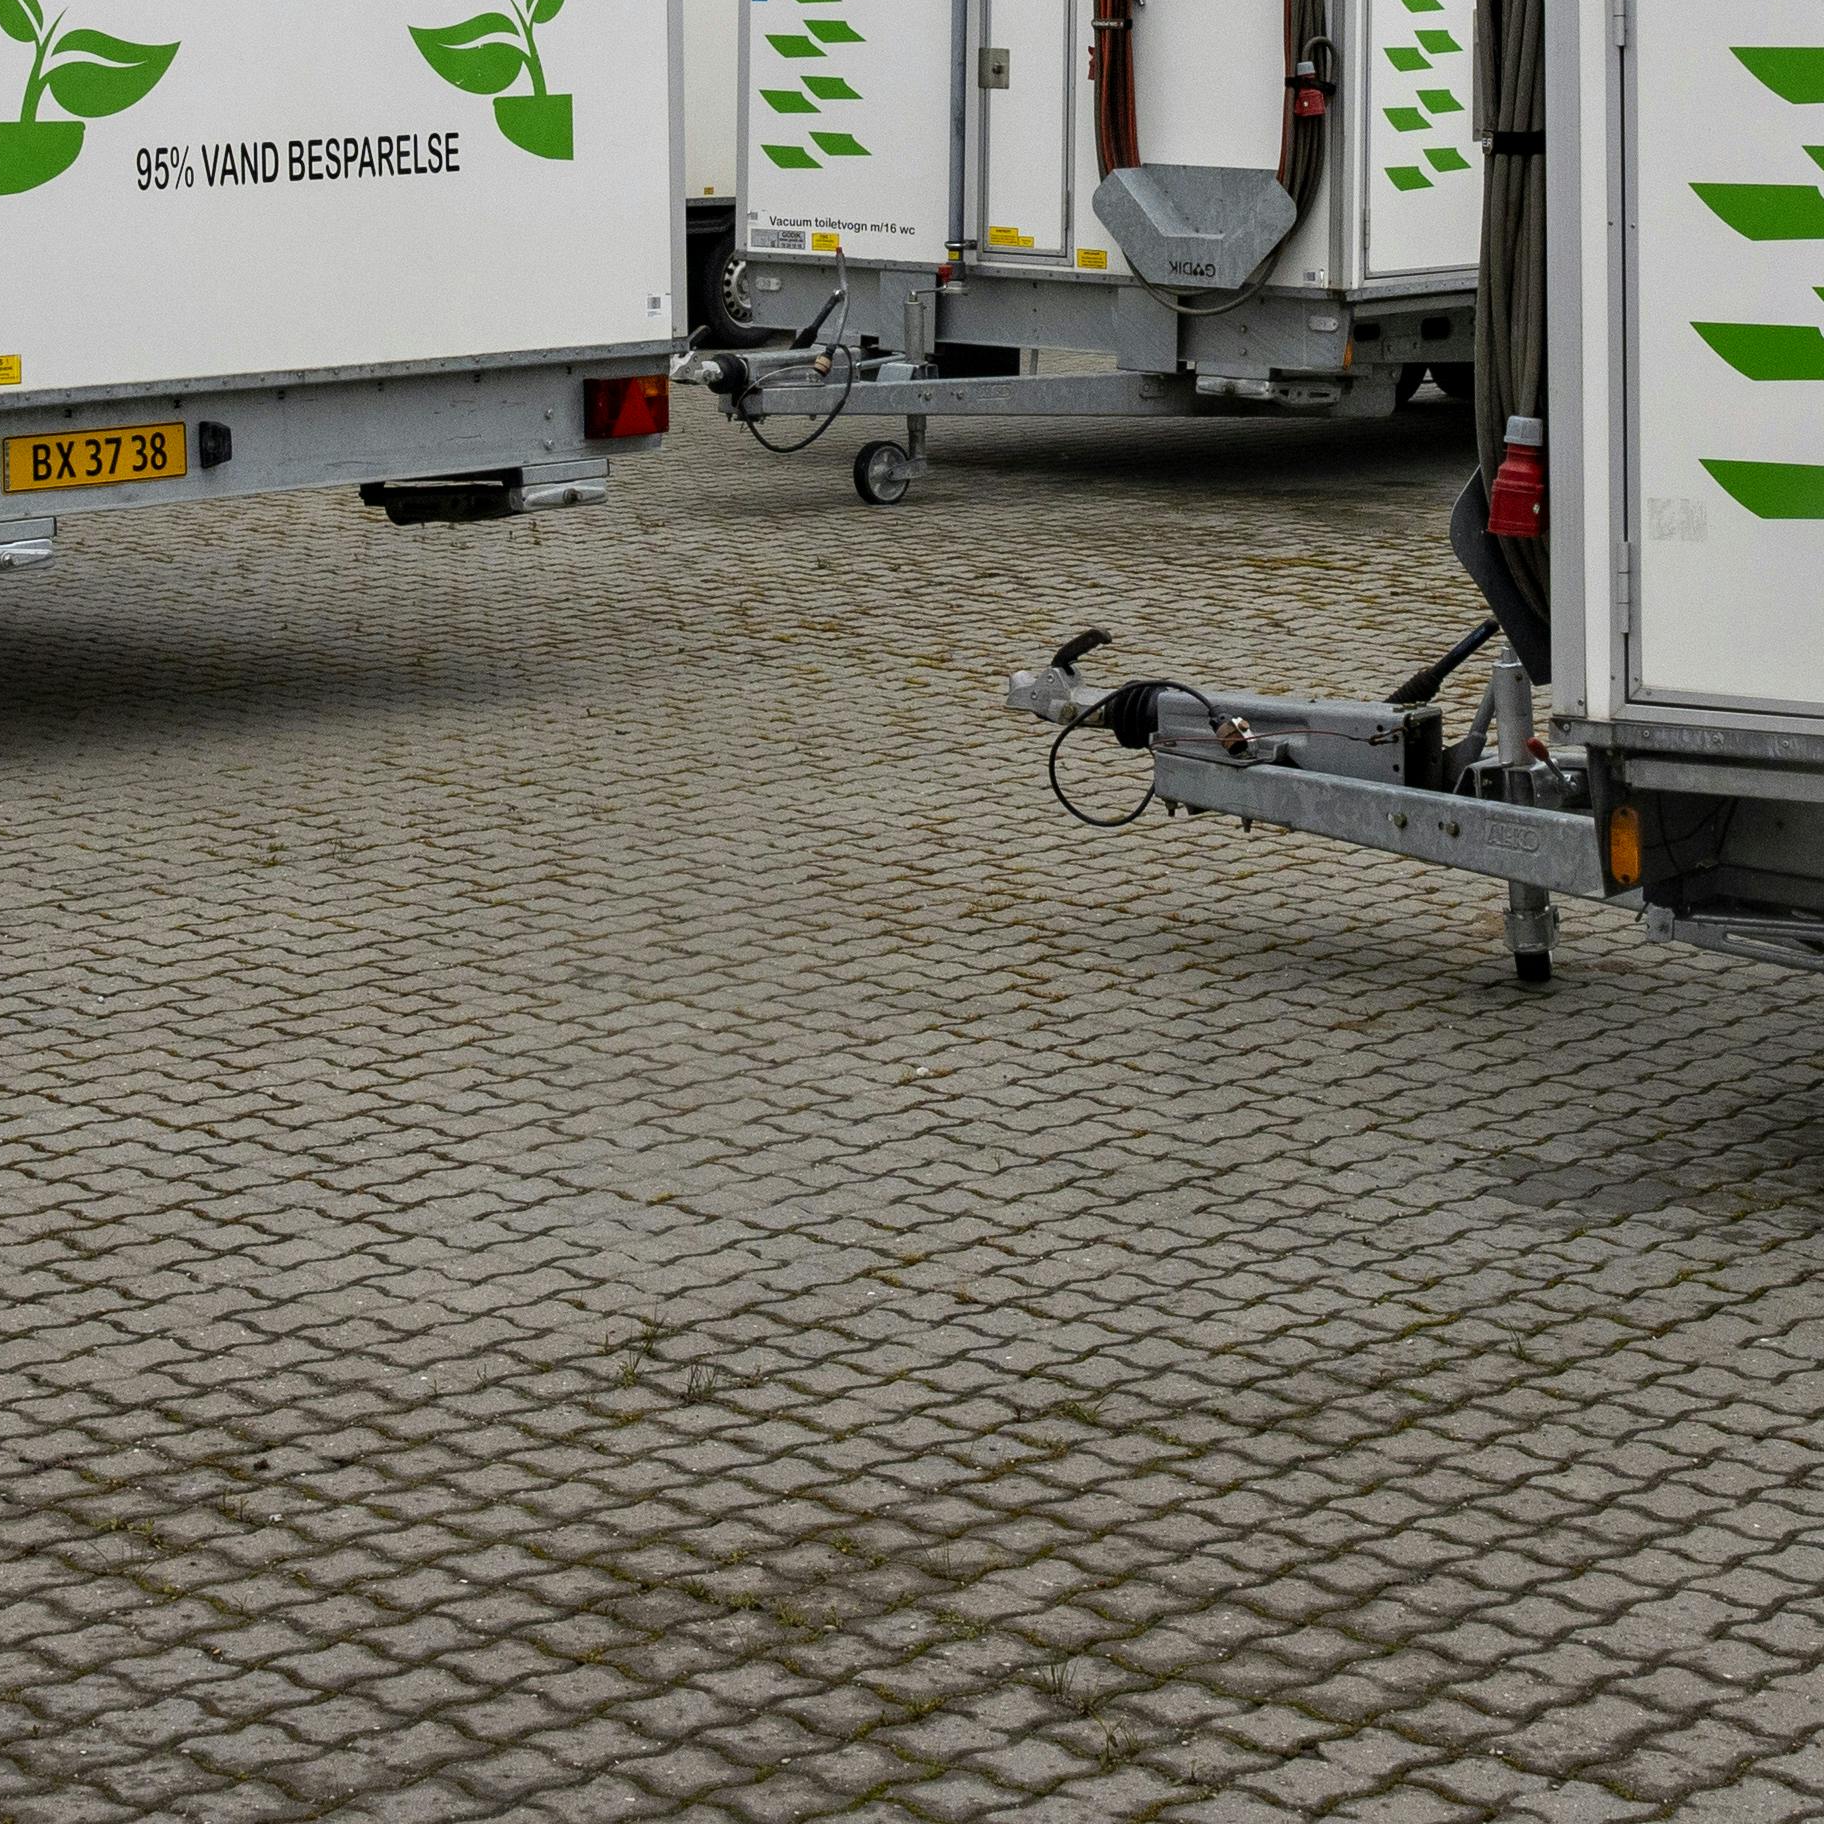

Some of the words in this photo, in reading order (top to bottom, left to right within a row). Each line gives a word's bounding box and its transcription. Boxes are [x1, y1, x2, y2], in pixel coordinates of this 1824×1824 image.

[136, 145, 194, 191] 95%
[201, 142, 279, 187] VAND
[288, 132, 461, 182] BESPARELSE
[769, 215, 812, 228] Vacuum
[814, 217, 868, 233] toiletvogn
[870, 222, 897, 234] m/16
[900, 225, 916, 236] wc
[32, 441, 76, 481] BX
[85, 437, 122, 477] 37
[131, 432, 168, 472] 38
